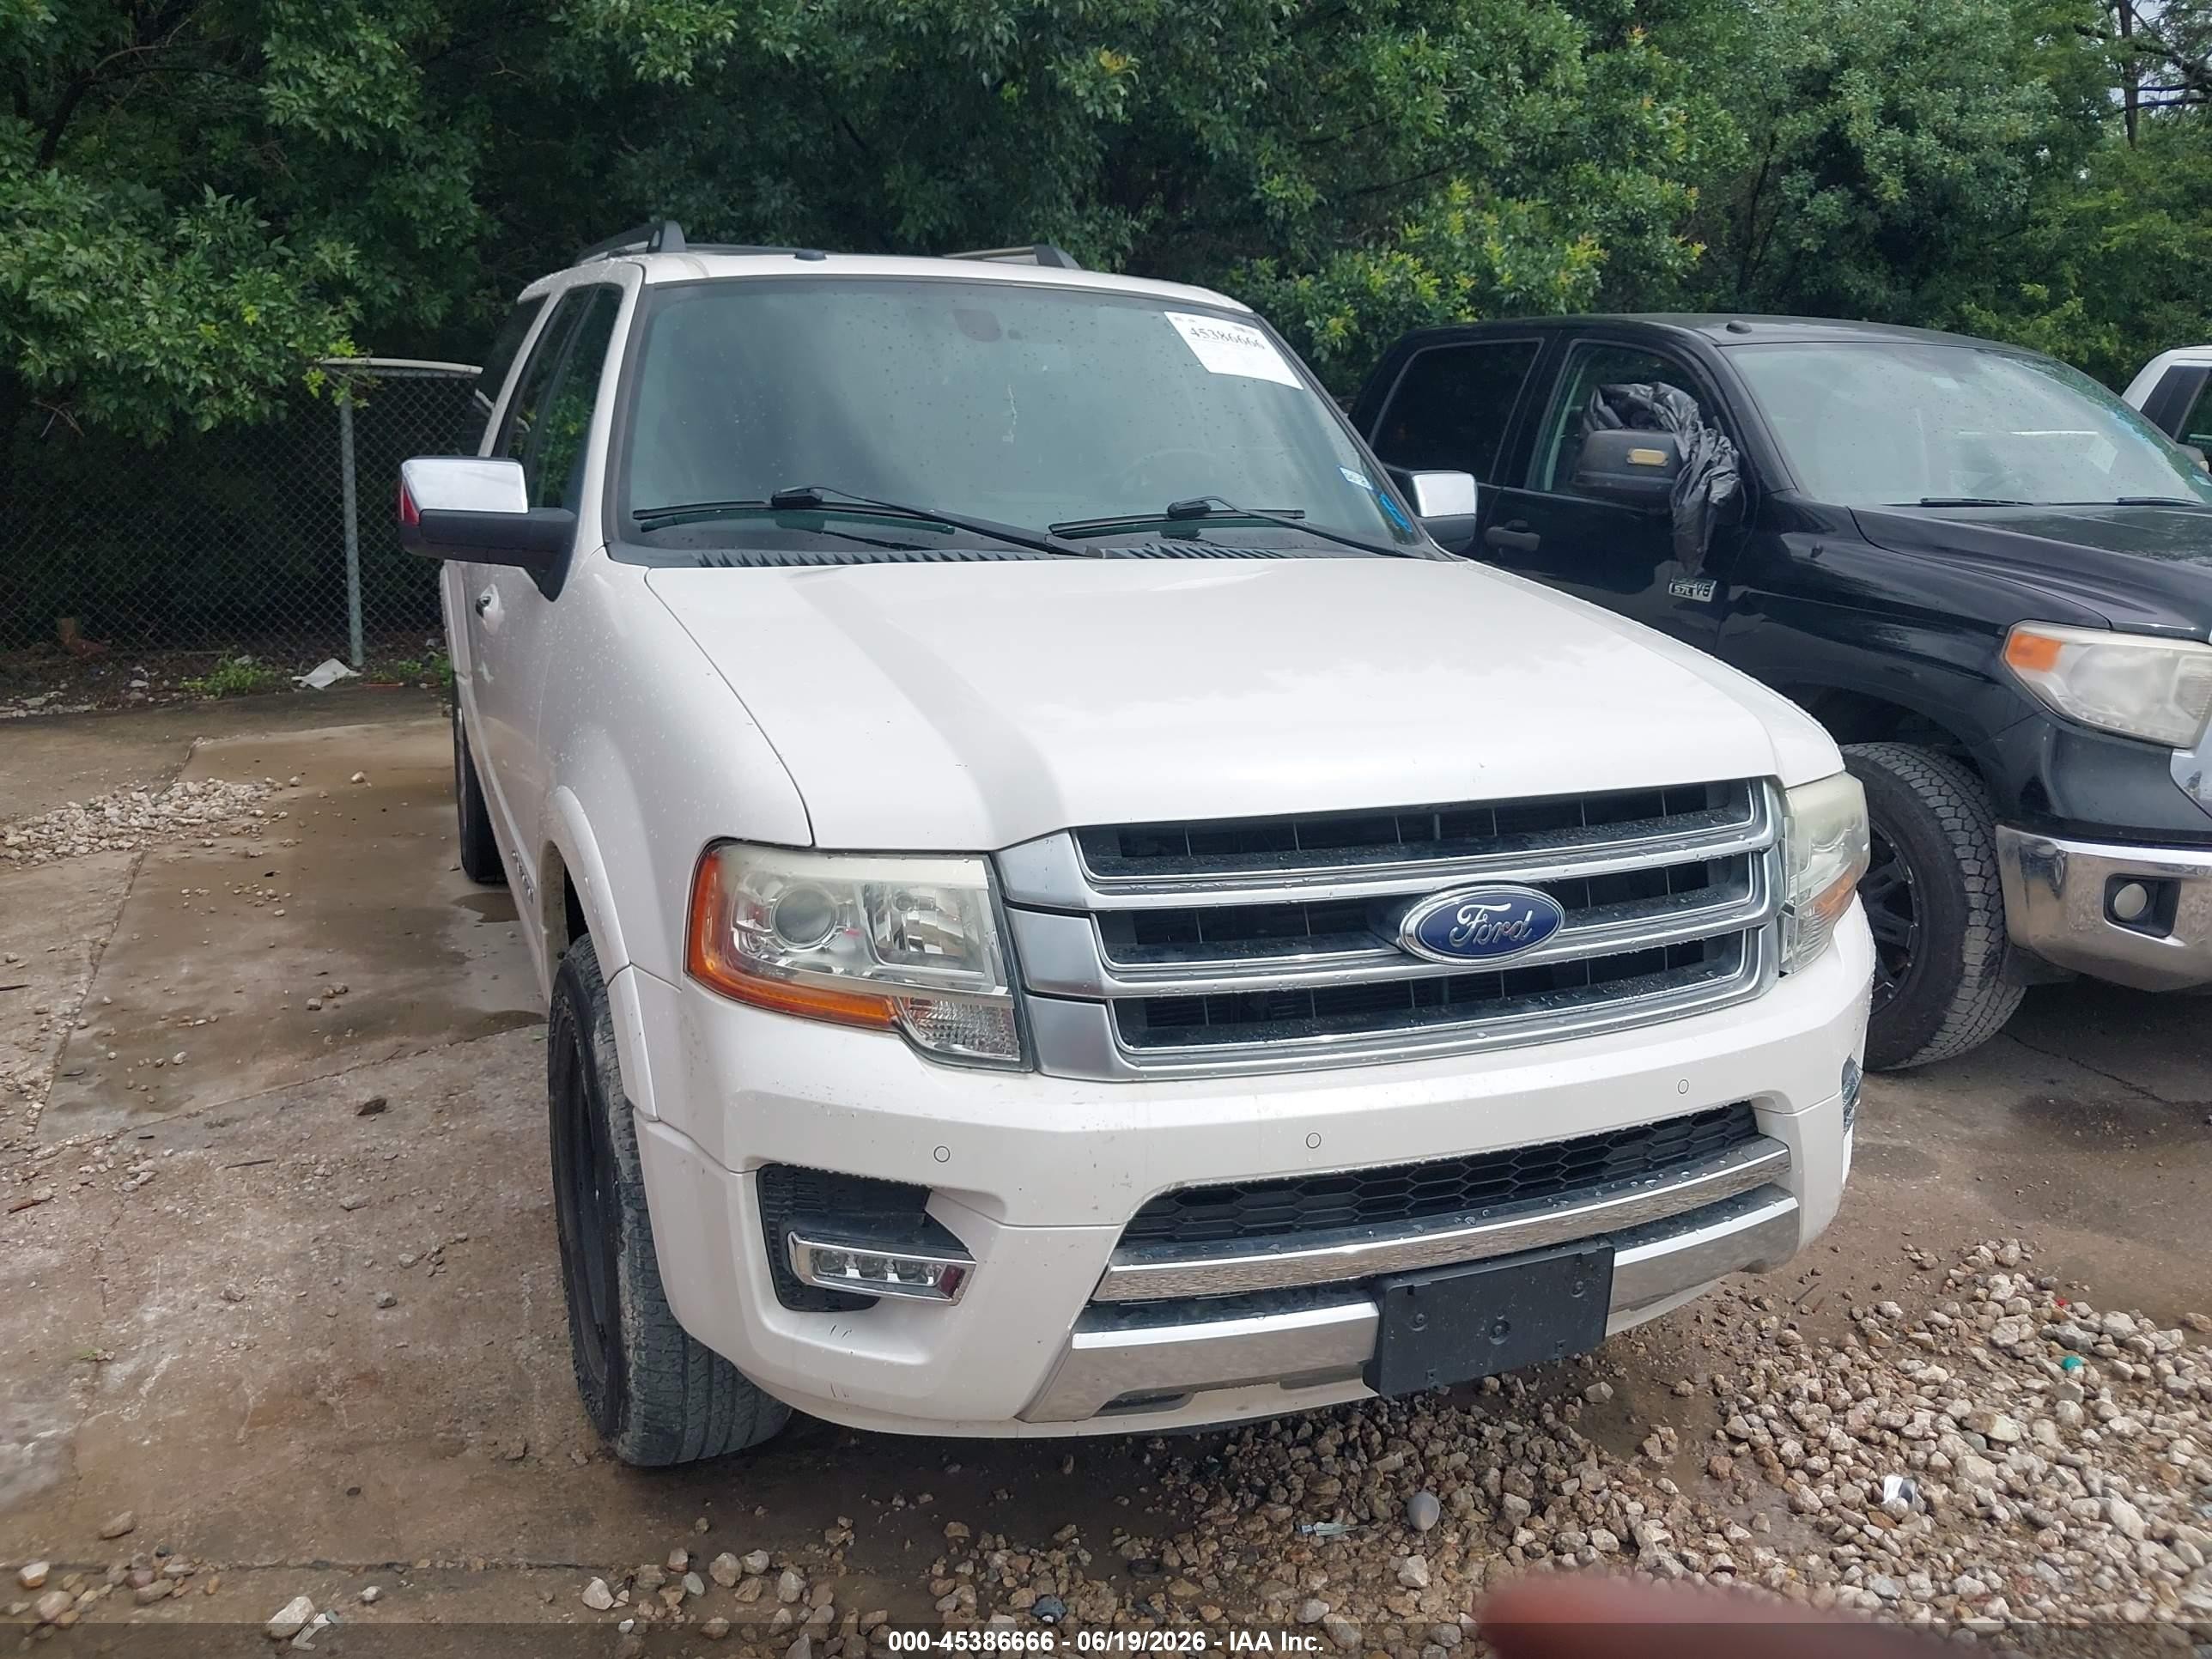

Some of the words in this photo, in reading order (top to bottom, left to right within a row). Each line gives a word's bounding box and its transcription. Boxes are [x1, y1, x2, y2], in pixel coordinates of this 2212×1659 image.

[1189, 327, 1266, 349] 45386666
[1697, 583, 1711, 598] V8
[1449, 902, 1533, 947] Ford
